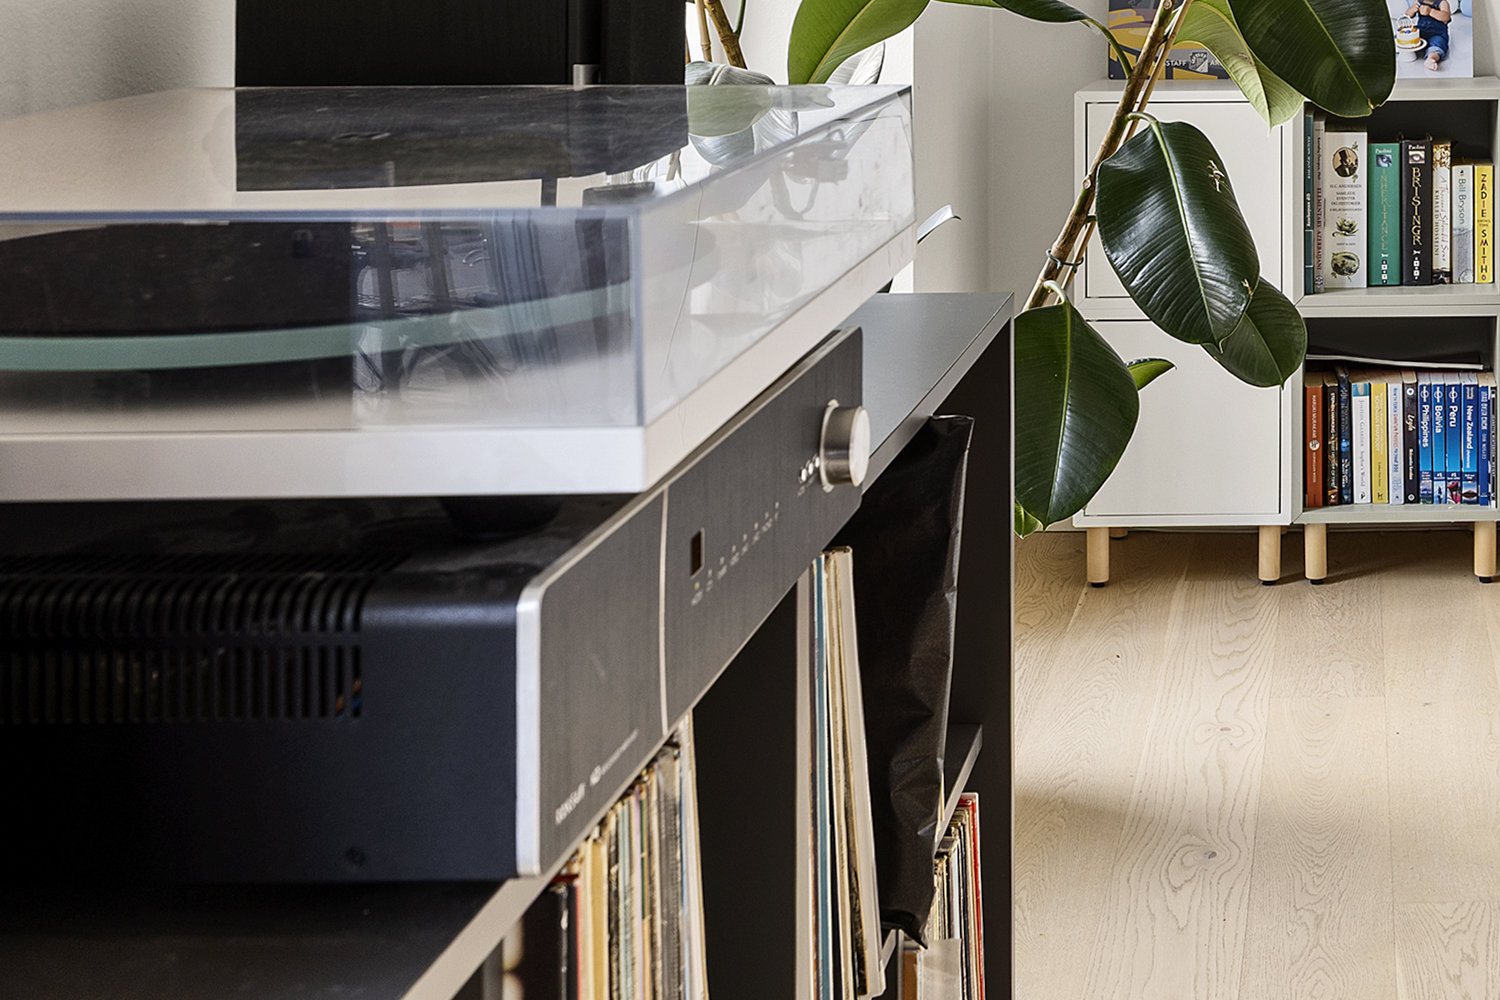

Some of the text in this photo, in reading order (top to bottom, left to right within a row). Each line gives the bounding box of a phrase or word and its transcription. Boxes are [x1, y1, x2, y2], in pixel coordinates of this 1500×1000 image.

[1458, 178, 1467, 192] Bill
[1480, 174, 1488, 218] ZADIE
[1411, 167, 1423, 246] BRISINGR
[1457, 194, 1467, 225] Bryson
[1480, 229, 1489, 273] SMITH
[1421, 404, 1430, 448] Philippines
[1435, 405, 1443, 433] Bolivia
[1449, 405, 1458, 427] Peru
[1466, 422, 1474, 449] Zealand
